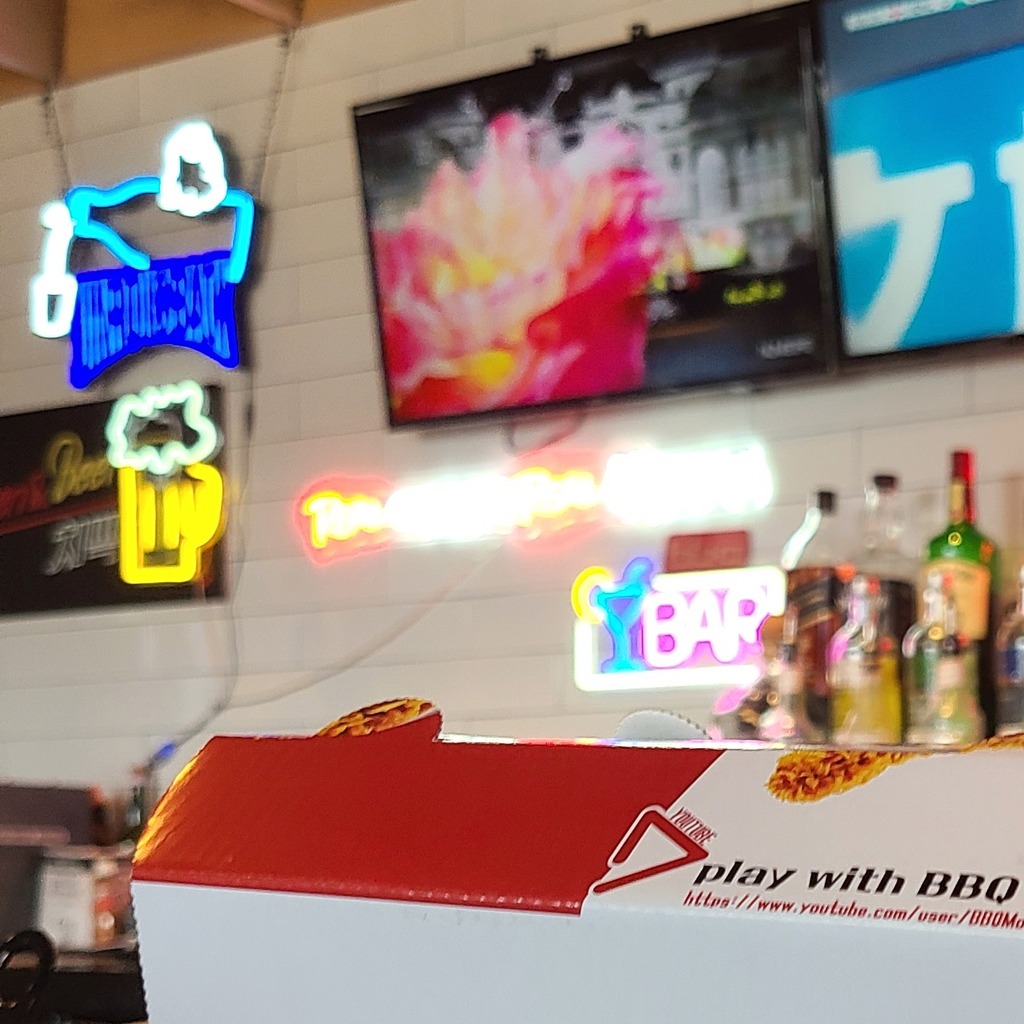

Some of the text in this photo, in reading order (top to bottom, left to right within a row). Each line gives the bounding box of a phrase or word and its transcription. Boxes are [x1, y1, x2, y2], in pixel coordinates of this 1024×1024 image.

[642, 584, 768, 670] BAR
[693, 860, 1021, 905] play with BBQ
